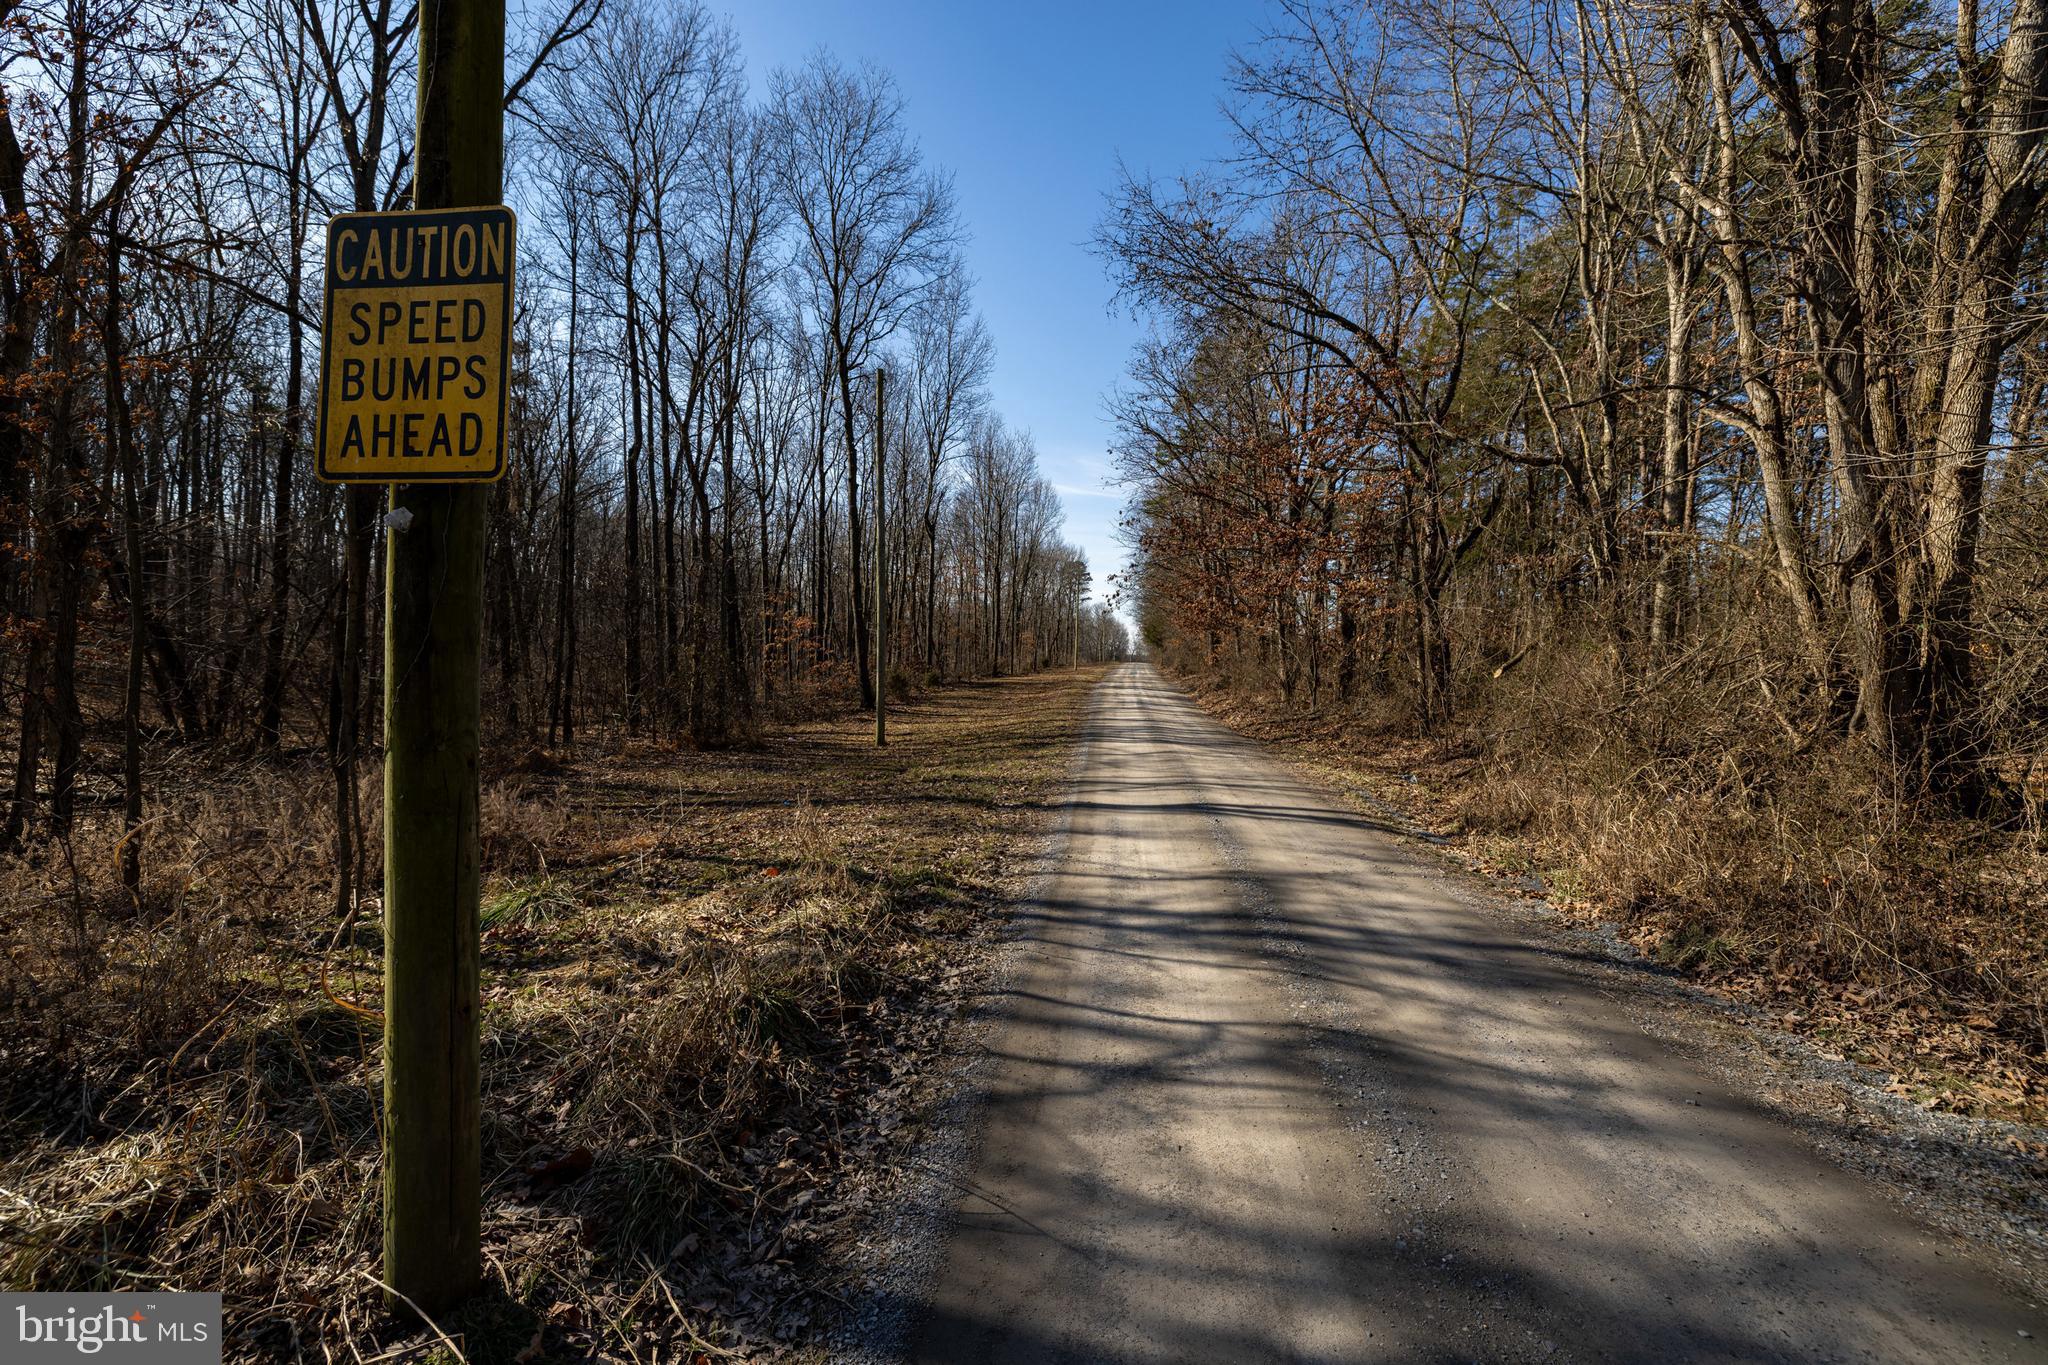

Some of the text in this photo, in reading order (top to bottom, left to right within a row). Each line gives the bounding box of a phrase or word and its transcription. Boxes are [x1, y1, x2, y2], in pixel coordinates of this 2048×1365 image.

[335, 222, 505, 282] CAUTION
[348, 298, 486, 346] SPEED
[341, 355, 487, 401] BUMPS
[340, 412, 483, 458] AHEAD
